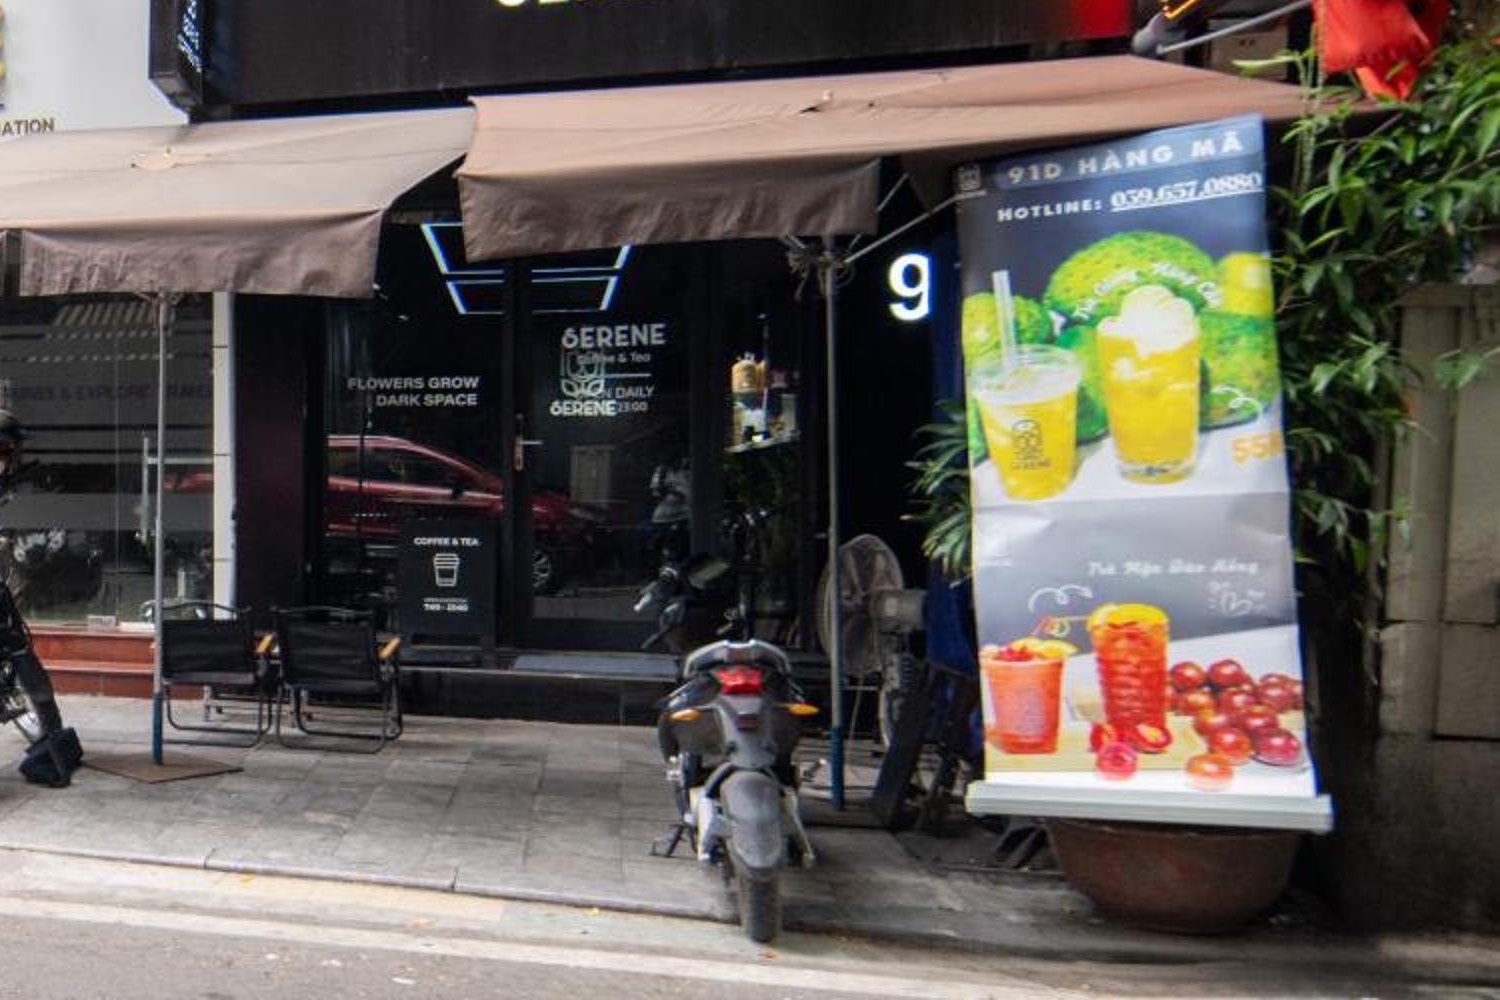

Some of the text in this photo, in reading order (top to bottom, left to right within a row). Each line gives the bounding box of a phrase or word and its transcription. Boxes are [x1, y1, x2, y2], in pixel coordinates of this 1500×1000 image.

[1007, 131, 1244, 184] 91D HÀNG MÃ
[997, 199, 1102, 223] HOTLINE:
[561, 323, 666, 350] SERENE
[347, 376, 480, 390] FLOWERS GROW
[615, 385, 655, 399] DAILY
[375, 393, 478, 407] DARK SPACE
